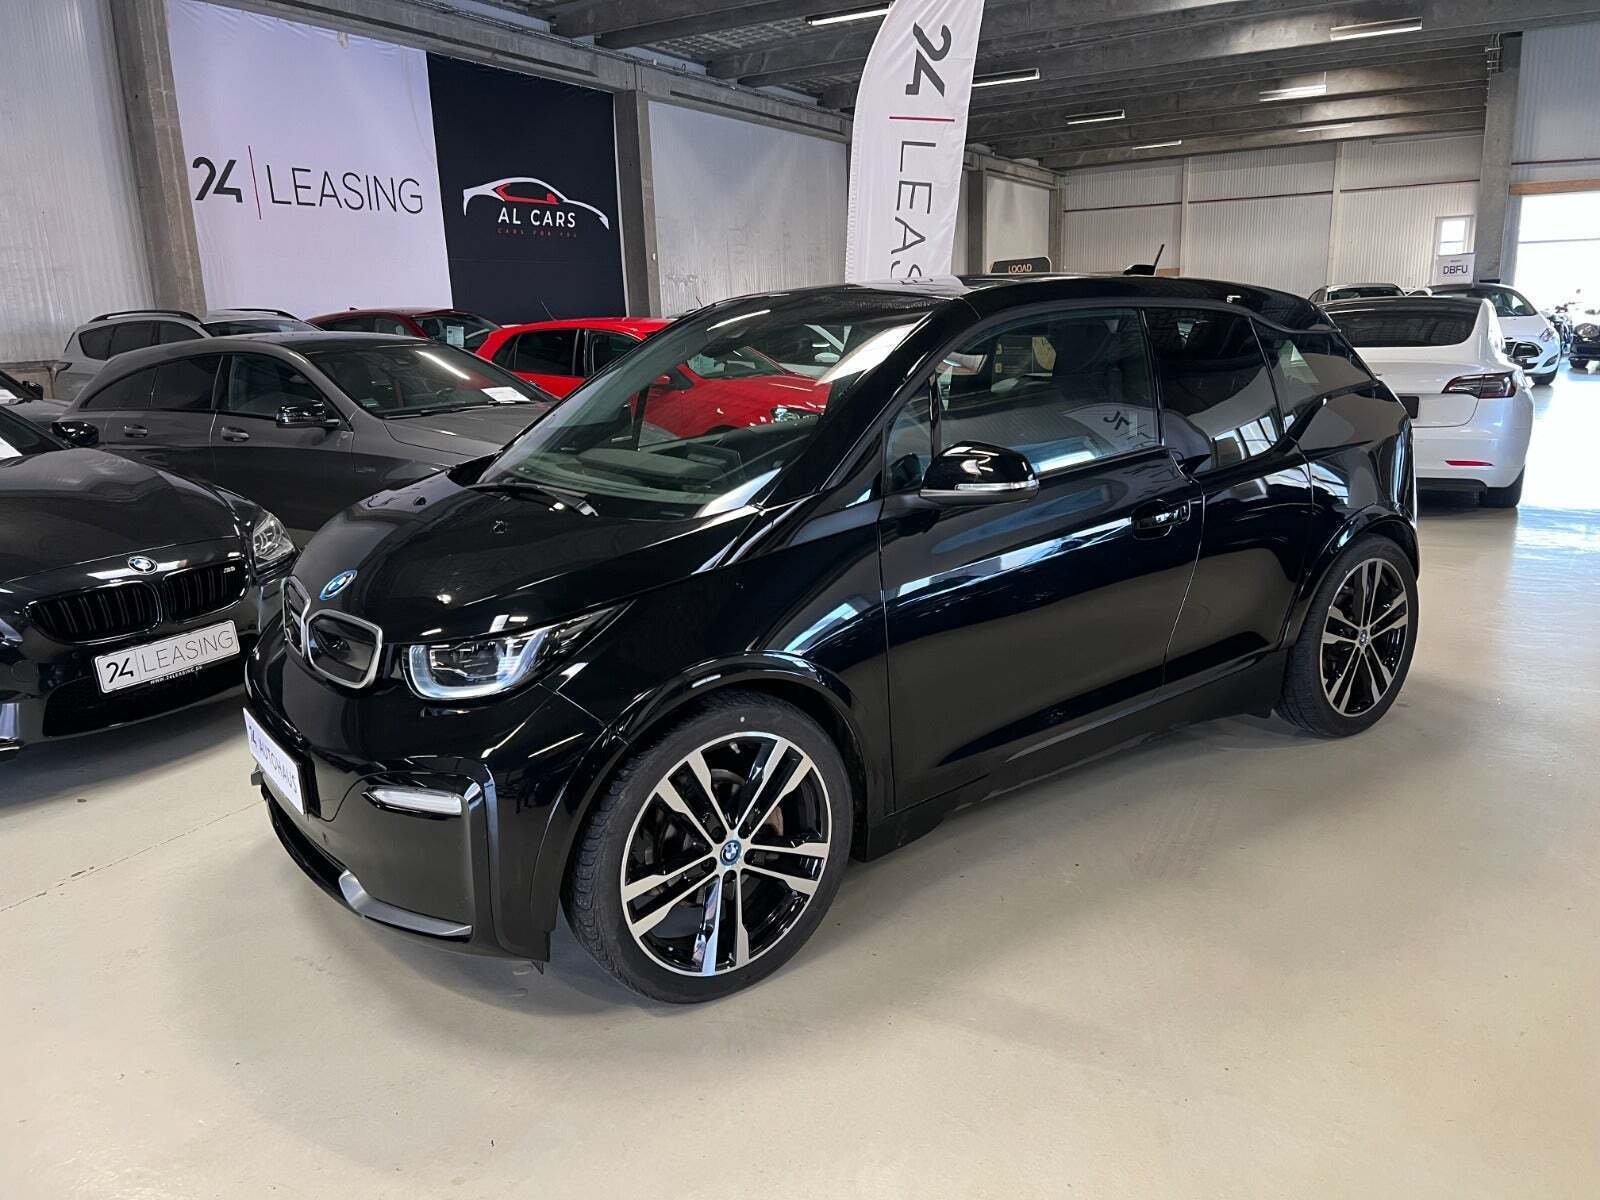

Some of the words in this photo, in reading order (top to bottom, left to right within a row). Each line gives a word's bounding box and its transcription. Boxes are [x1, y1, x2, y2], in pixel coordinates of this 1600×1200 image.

[905, 21, 952, 97] 24
[191, 156, 243, 203] 24
[266, 164, 424, 215] LEASING
[497, 207, 521, 225] AL
[530, 209, 576, 228] CARS
[1443, 265, 1468, 275] DBFU
[105, 657, 134, 683] 24
[140, 630, 235, 673] LEASING
[259, 739, 298, 794] AUTOHAUS
